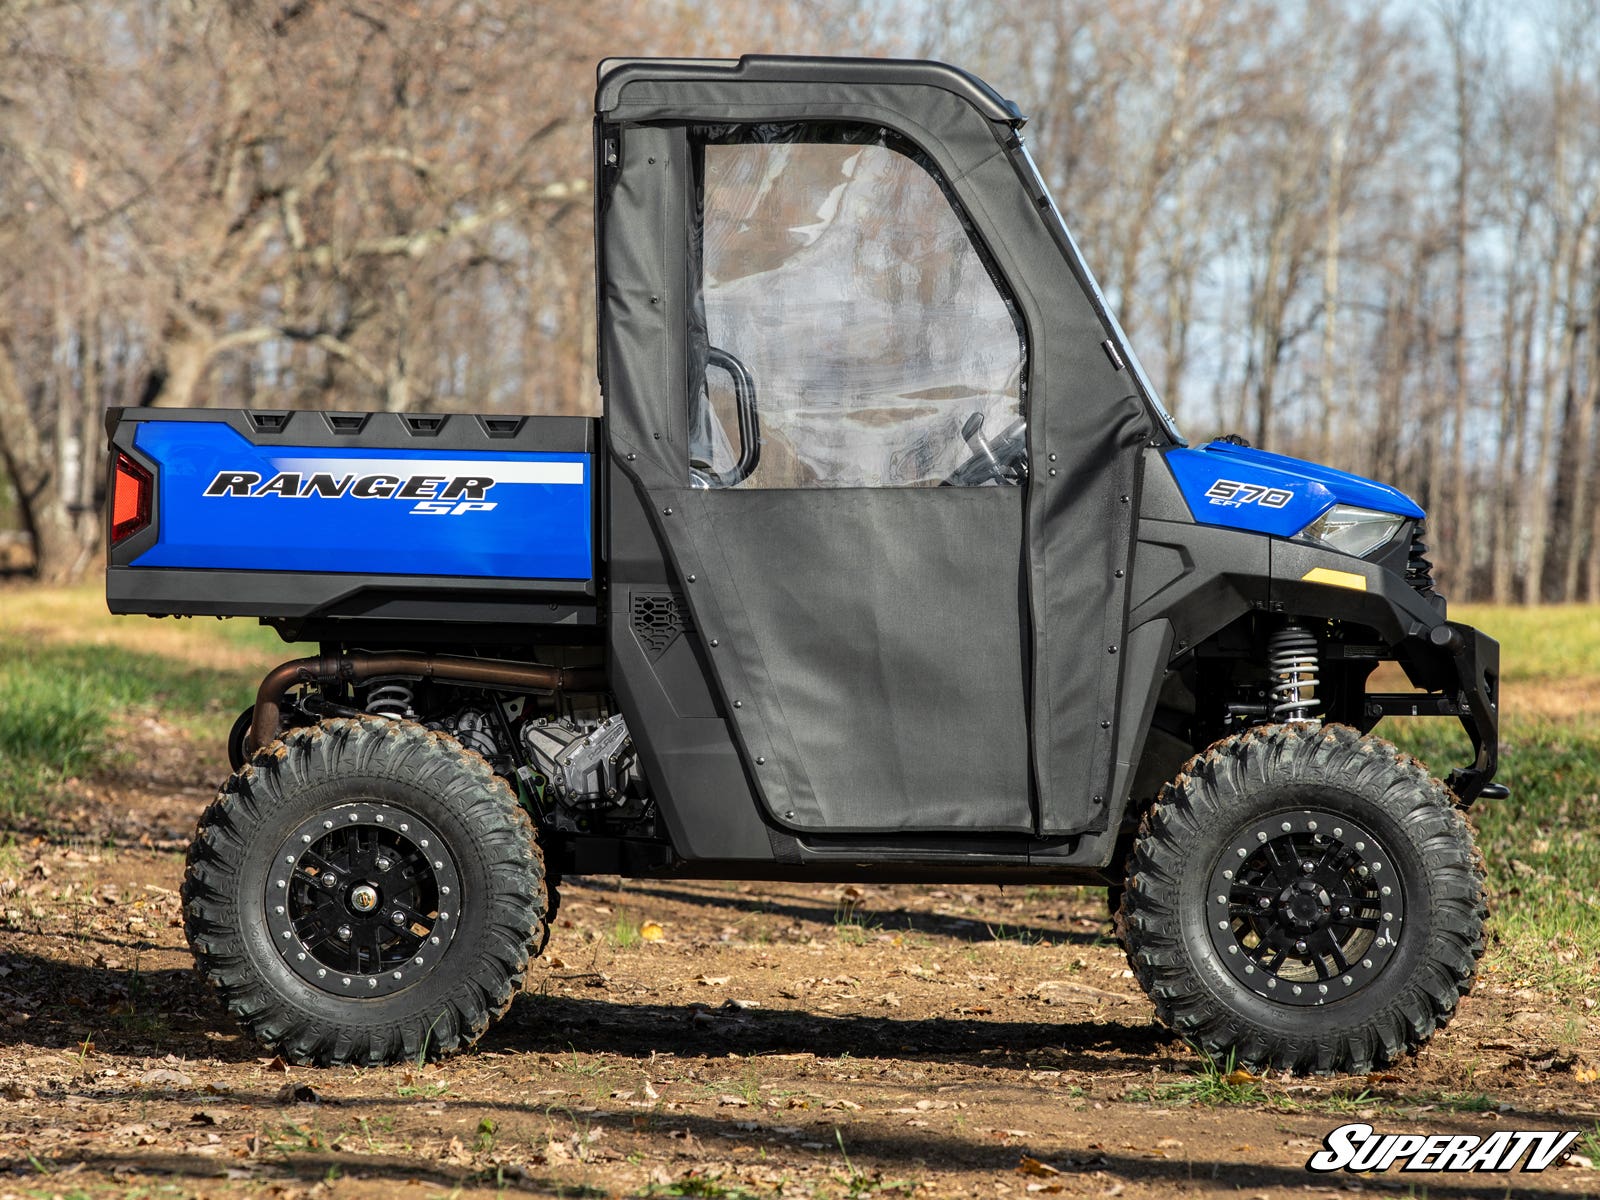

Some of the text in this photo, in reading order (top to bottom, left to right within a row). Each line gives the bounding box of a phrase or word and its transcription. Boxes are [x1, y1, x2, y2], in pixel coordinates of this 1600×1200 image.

[203, 470, 497, 500] RANGER
[1204, 478, 1294, 508] 570
[409, 501, 498, 515] SP
[1209, 497, 1242, 508] EFI
